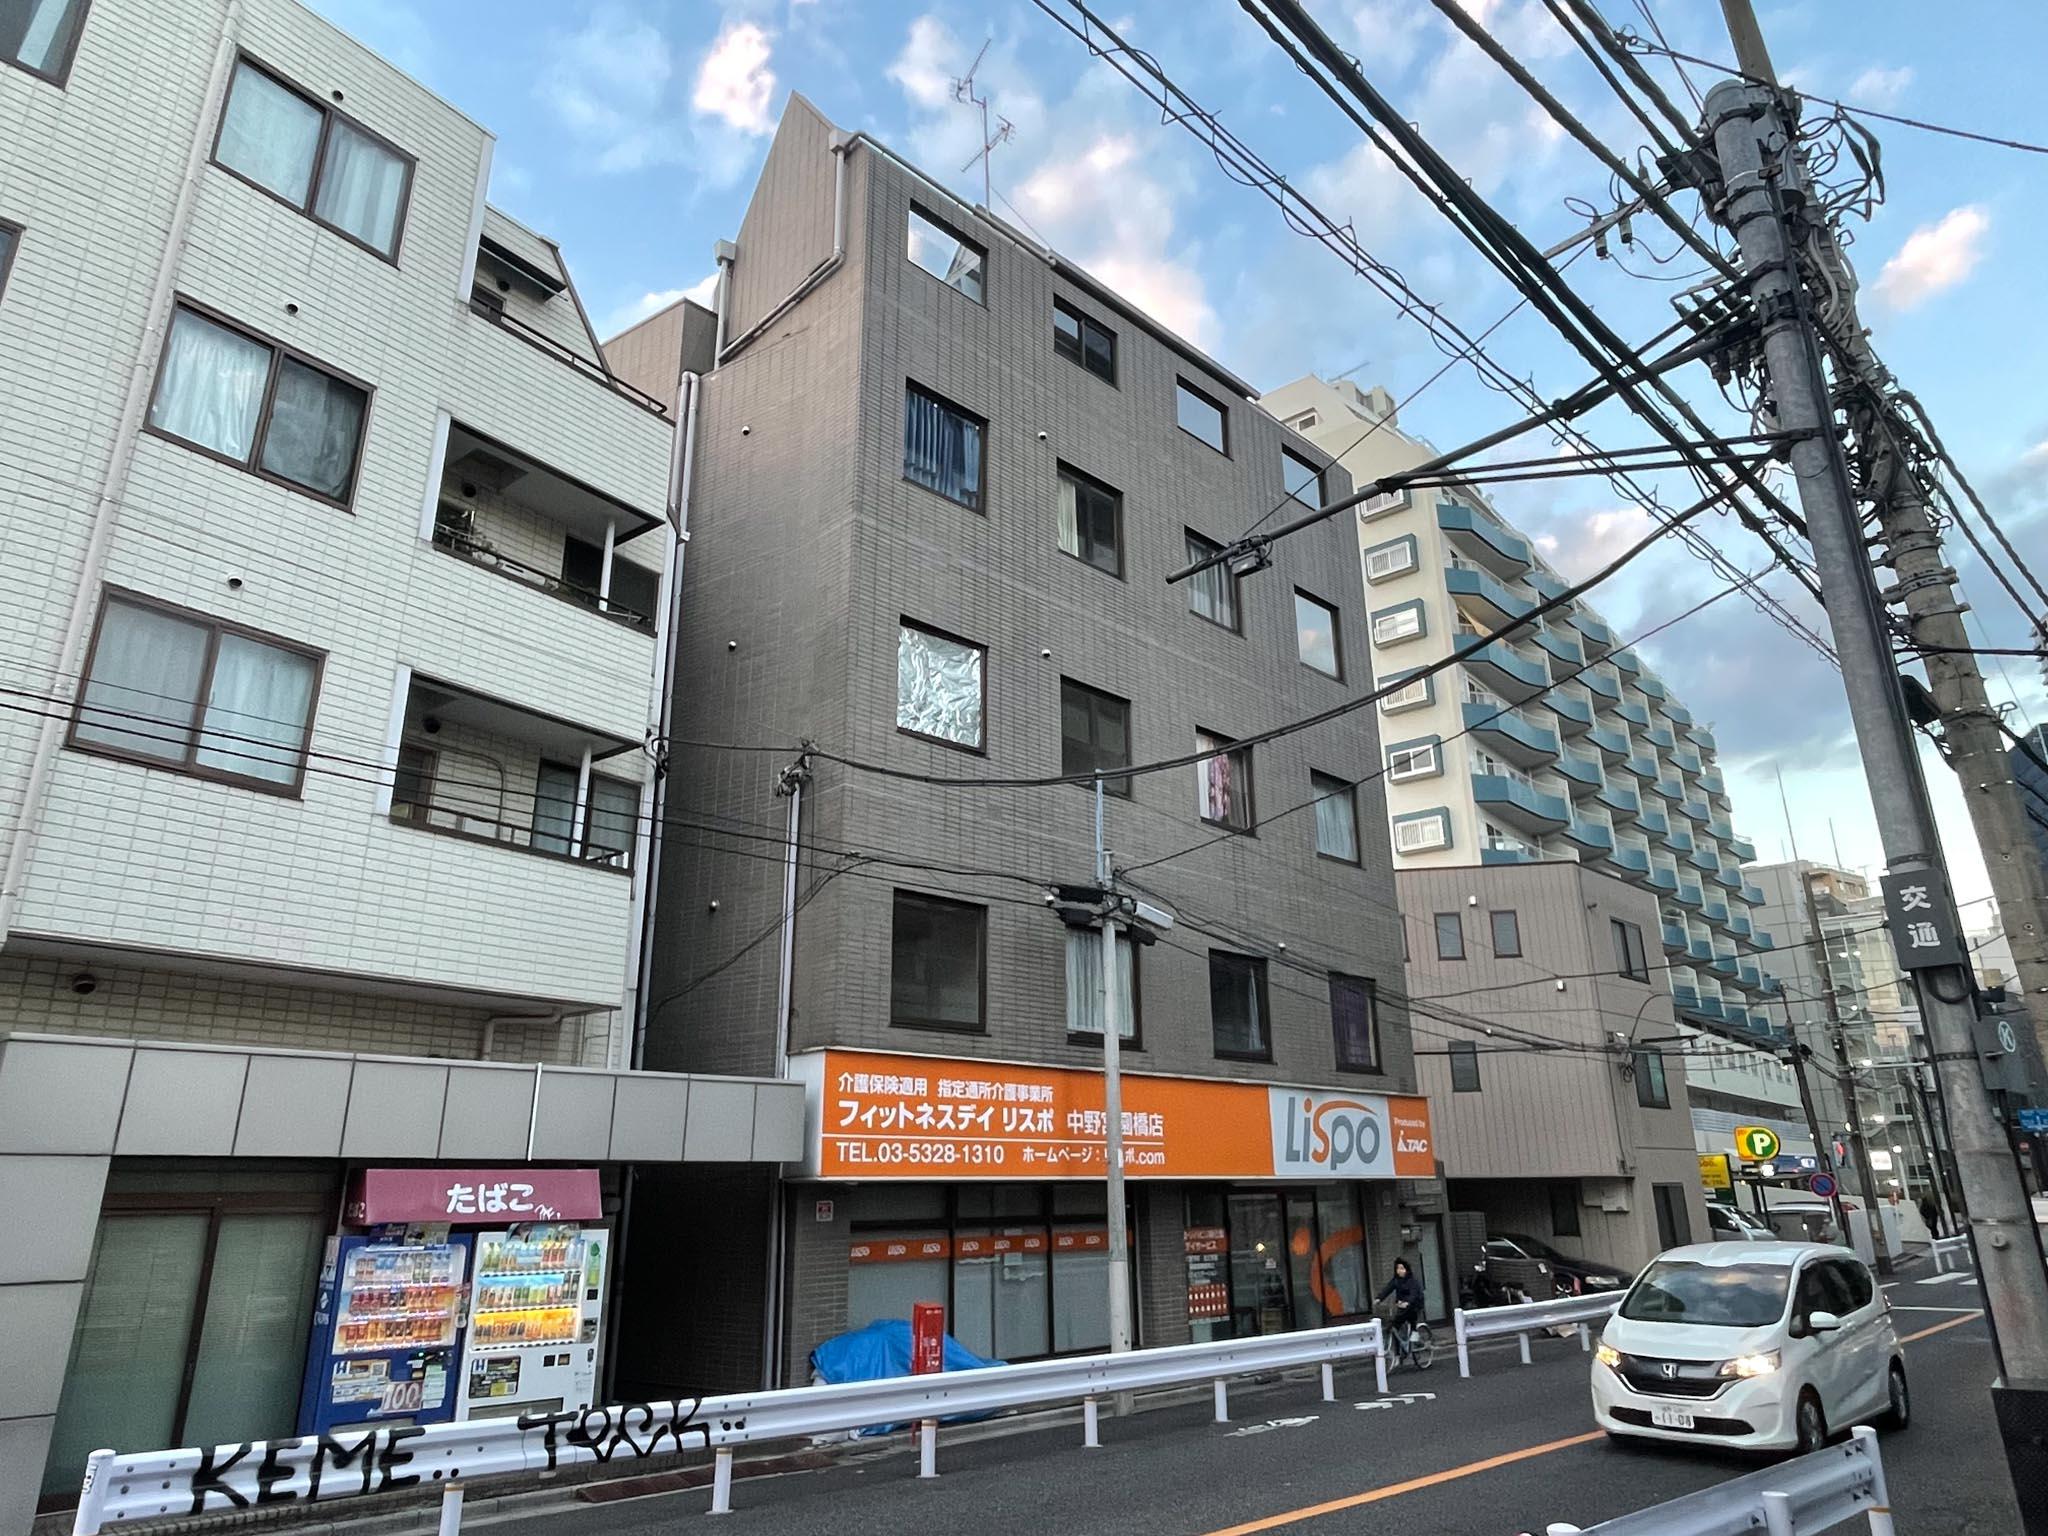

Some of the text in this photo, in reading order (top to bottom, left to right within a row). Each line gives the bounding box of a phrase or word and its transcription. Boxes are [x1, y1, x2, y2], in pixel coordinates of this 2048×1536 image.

[1900, 885, 1941, 948] 交通
[838, 1072, 1054, 1103] 介護保険適用 指定通所介護事業所
[838, 1100, 995, 1132] フィットネスデイ
[1002, 1107, 1055, 1133] リスポ
[1285, 1096, 1381, 1171] Lispo
[1752, 1133, 1771, 1155] P
[836, 1142, 1004, 1164] TEL.03-5328-1310
[446, 1183, 534, 1214] たばこ
[382, 1383, 421, 1411] 100
[189, 1427, 426, 1515] KEME
